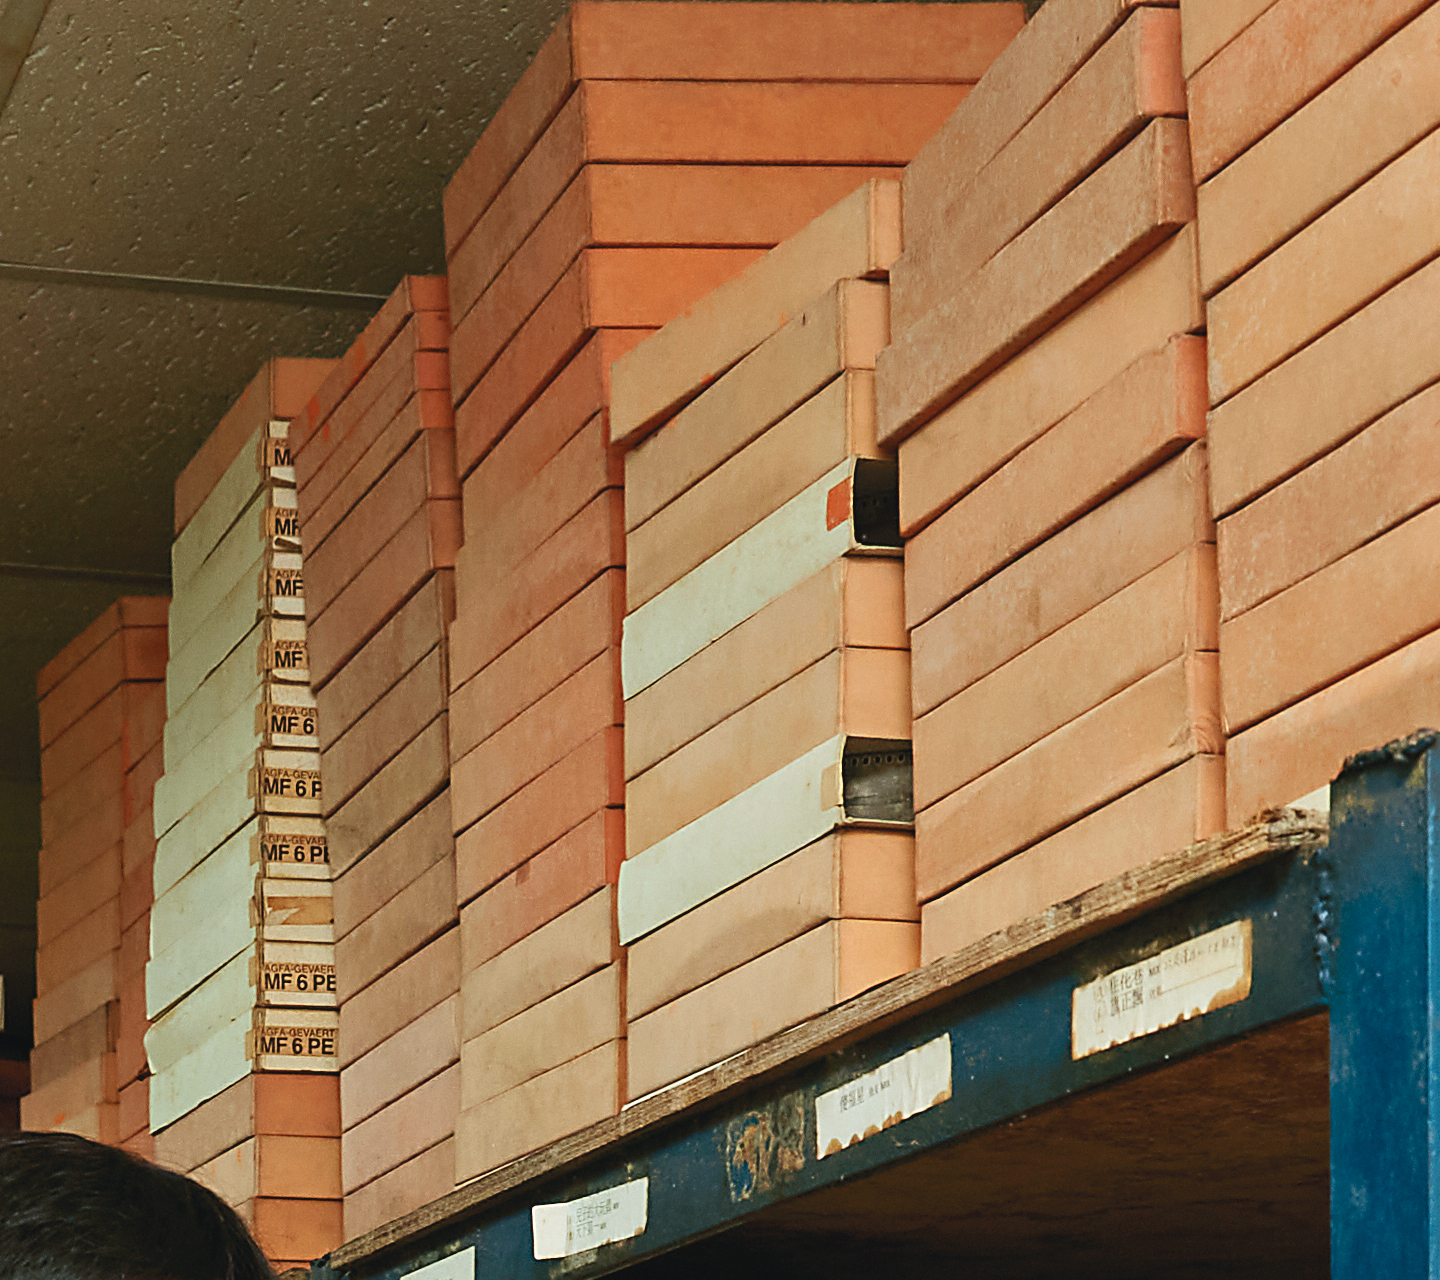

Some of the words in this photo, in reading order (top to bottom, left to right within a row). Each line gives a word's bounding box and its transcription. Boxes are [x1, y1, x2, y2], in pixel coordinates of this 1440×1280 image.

[276, 580, 303, 596] MF
[275, 651, 303, 668] MF
[272, 716, 299, 733] MF
[303, 718, 314, 734] 6
[264, 779, 291, 795] MF
[295, 781, 306, 797] 6
[261, 844, 289, 861] MF
[294, 846, 305, 862] 6
[264, 973, 292, 989] MF
[297, 975, 307, 991] 6
[313, 975, 336, 991] PE
[261, 1037, 288, 1053] MF
[292, 1038, 303, 1054] 6
[308, 1038, 334, 1055] PE
